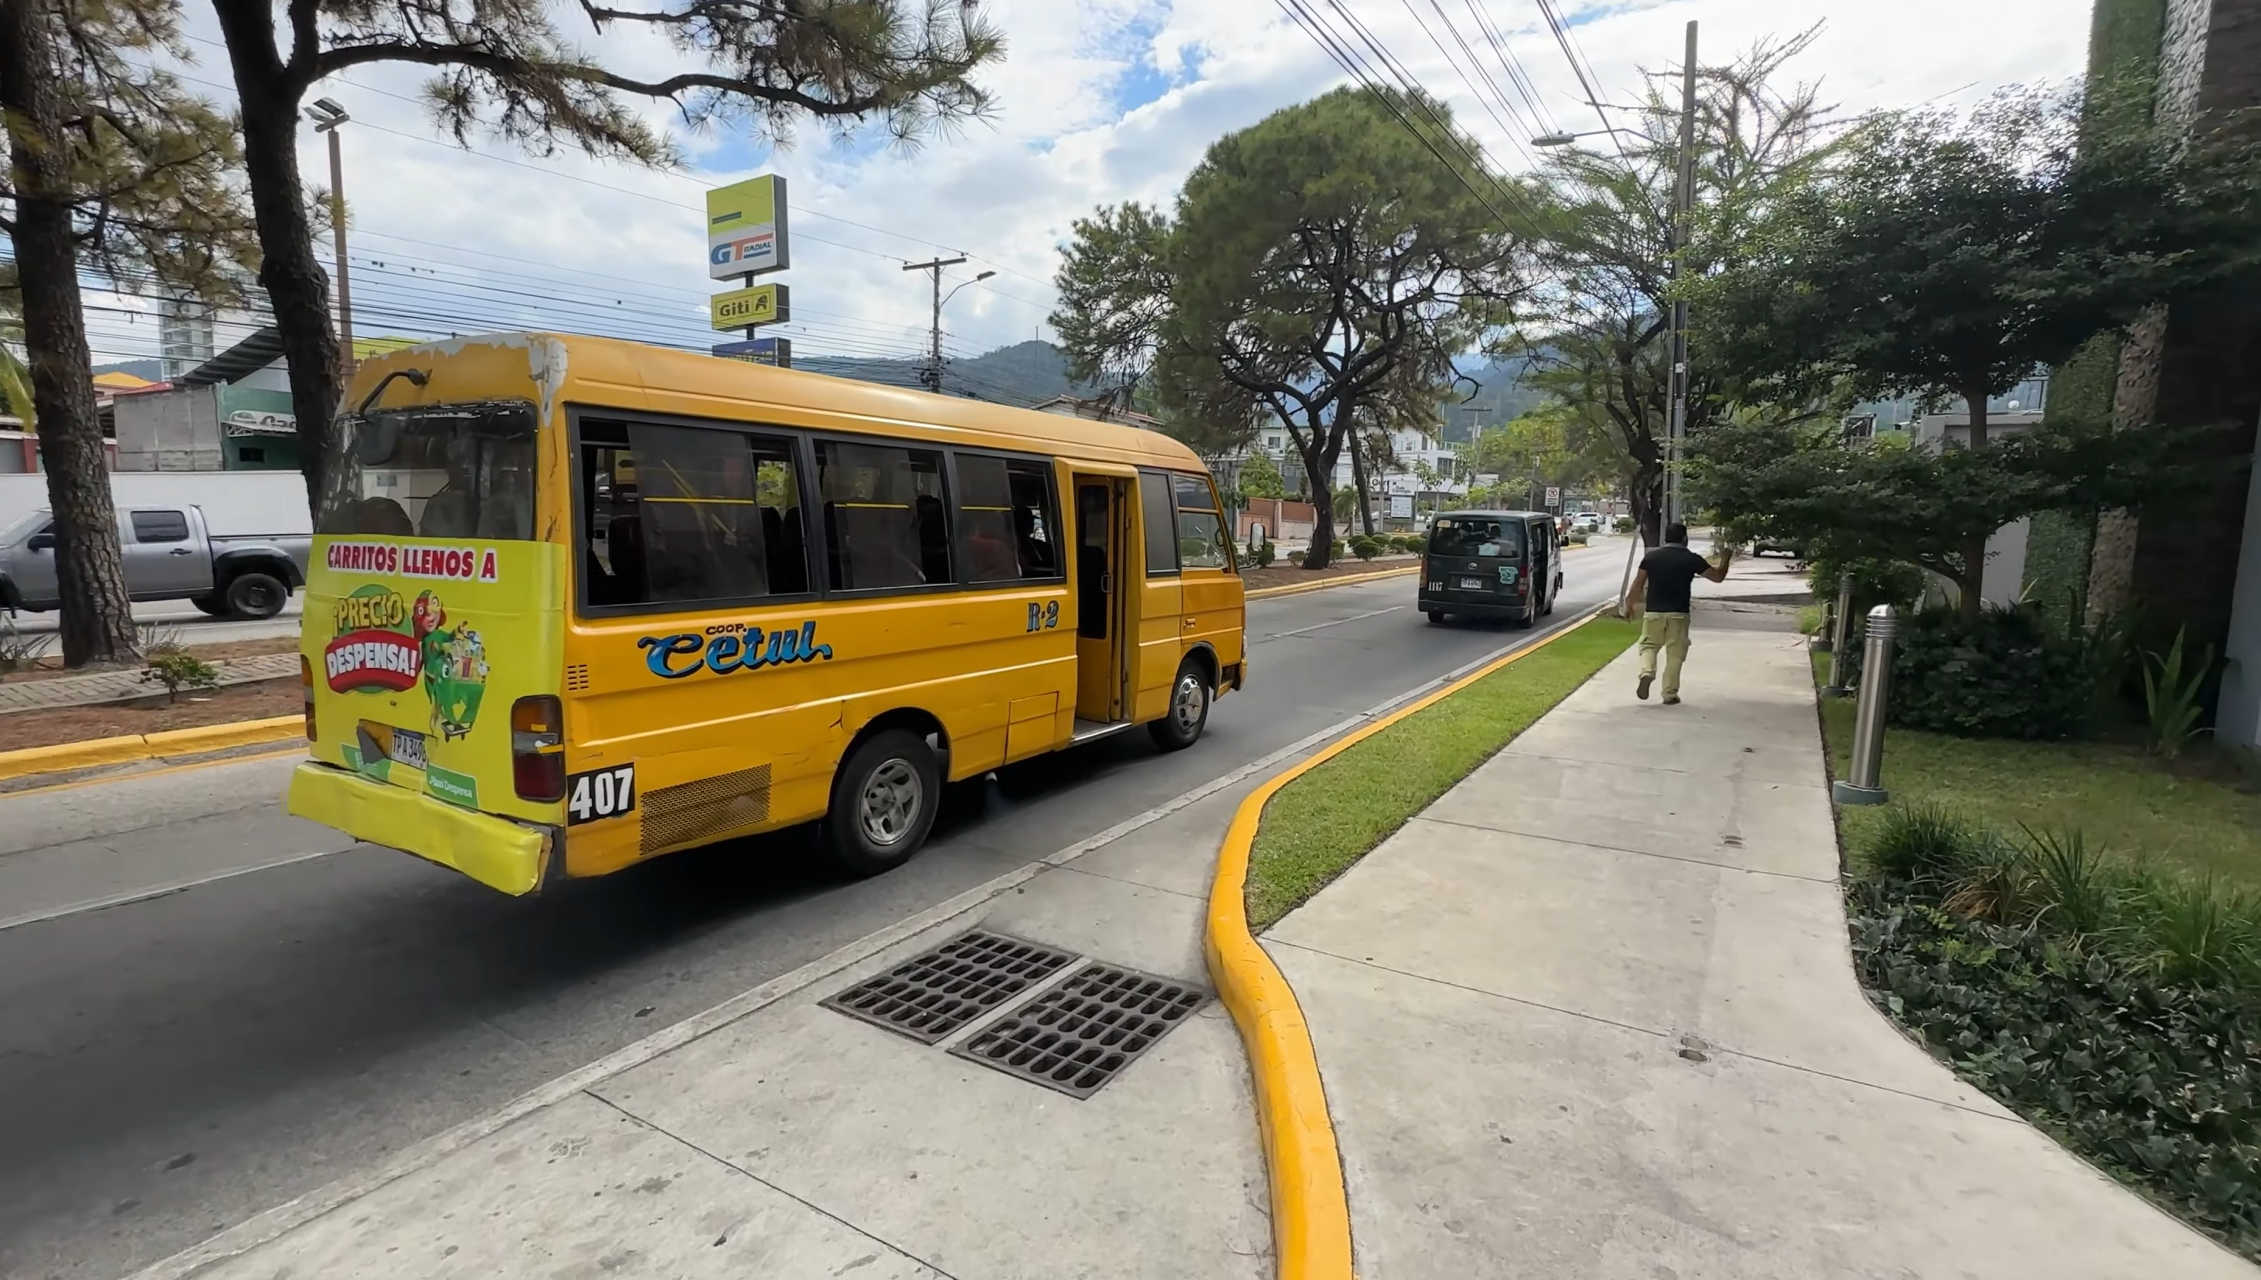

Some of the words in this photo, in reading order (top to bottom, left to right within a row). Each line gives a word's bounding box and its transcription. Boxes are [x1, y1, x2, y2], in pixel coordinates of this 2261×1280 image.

[711, 233, 773, 265] GT
[743, 242, 771, 253] RADIAL
[719, 300, 750, 317] Giti
[327, 544, 398, 573] CARRITOS
[402, 548, 474, 578] LLENOS
[481, 552, 496, 579] A
[705, 623, 748, 636] COOP.
[1026, 600, 1060, 633] R-2
[326, 642, 418, 681] DESPENSA!
[637, 620, 833, 679] Cetul
[444, 779, 473, 799] Despensa
[569, 767, 634, 820] 407
